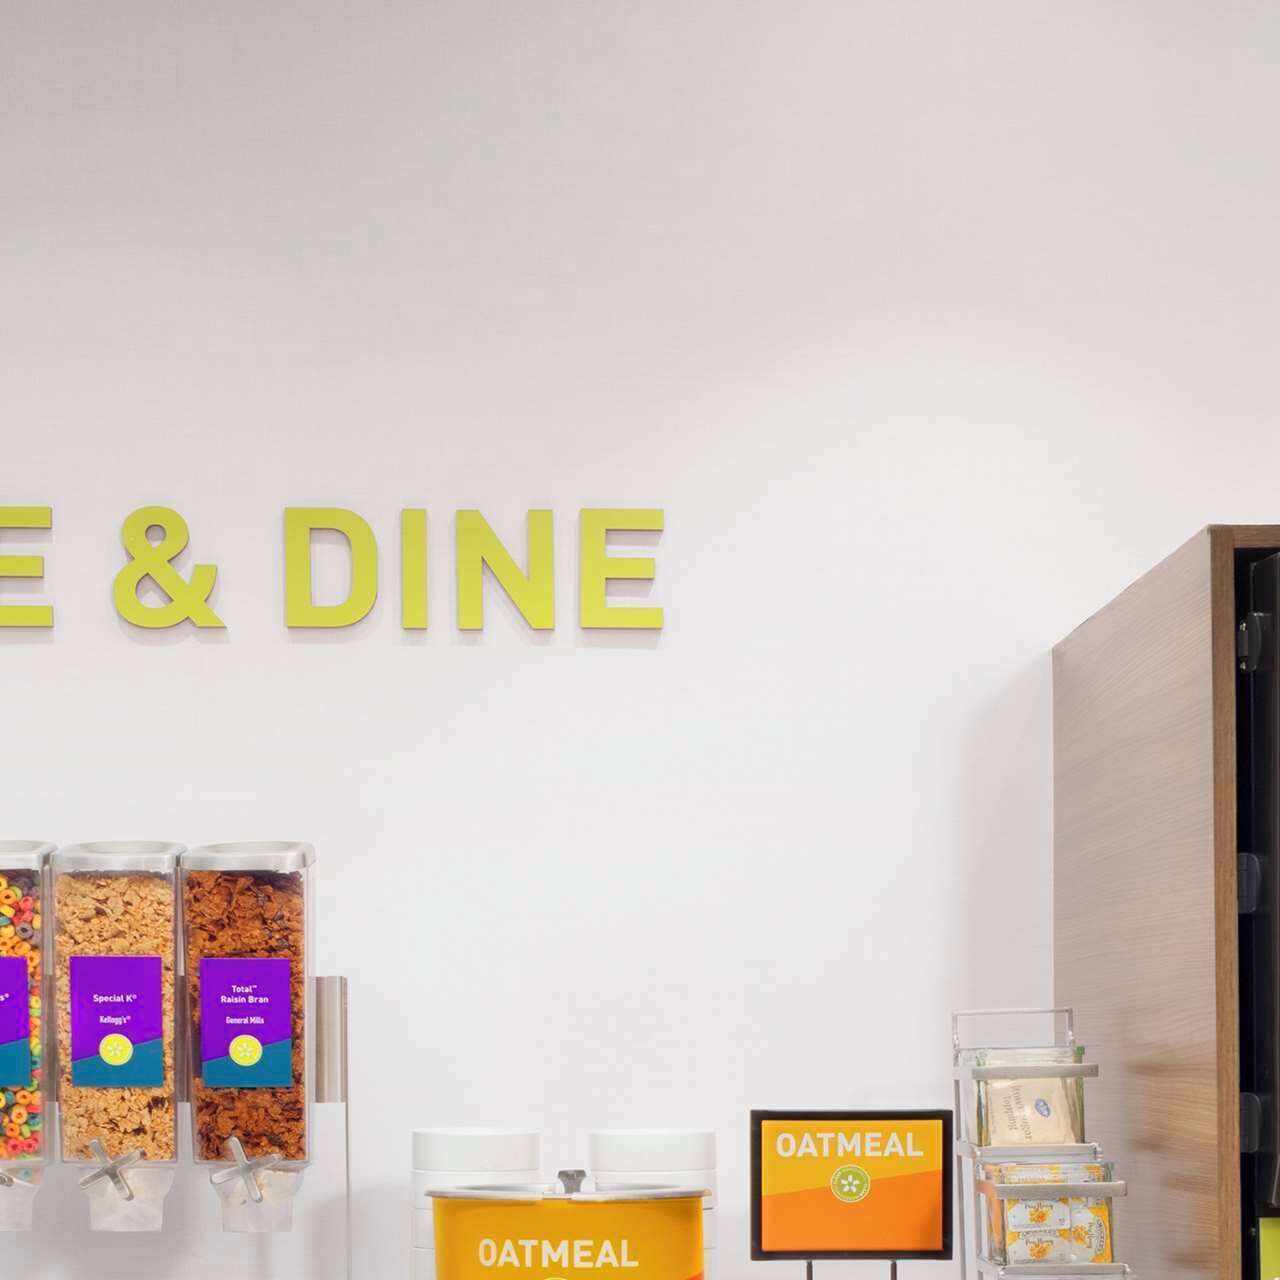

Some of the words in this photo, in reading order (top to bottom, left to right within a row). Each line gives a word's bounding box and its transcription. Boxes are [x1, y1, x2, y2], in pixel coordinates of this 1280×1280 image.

[113, 506, 226, 629] &
[284, 506, 666, 632] DINE
[93, 994, 123, 1004] Special
[220, 995, 246, 1003] Raisin
[248, 995, 269, 1003] Bran
[226, 1016, 248, 1025] General
[250, 1016, 264, 1025] Mills
[776, 1132, 924, 1159] OATMEAL
[478, 1238, 639, 1268] OATMEAL
